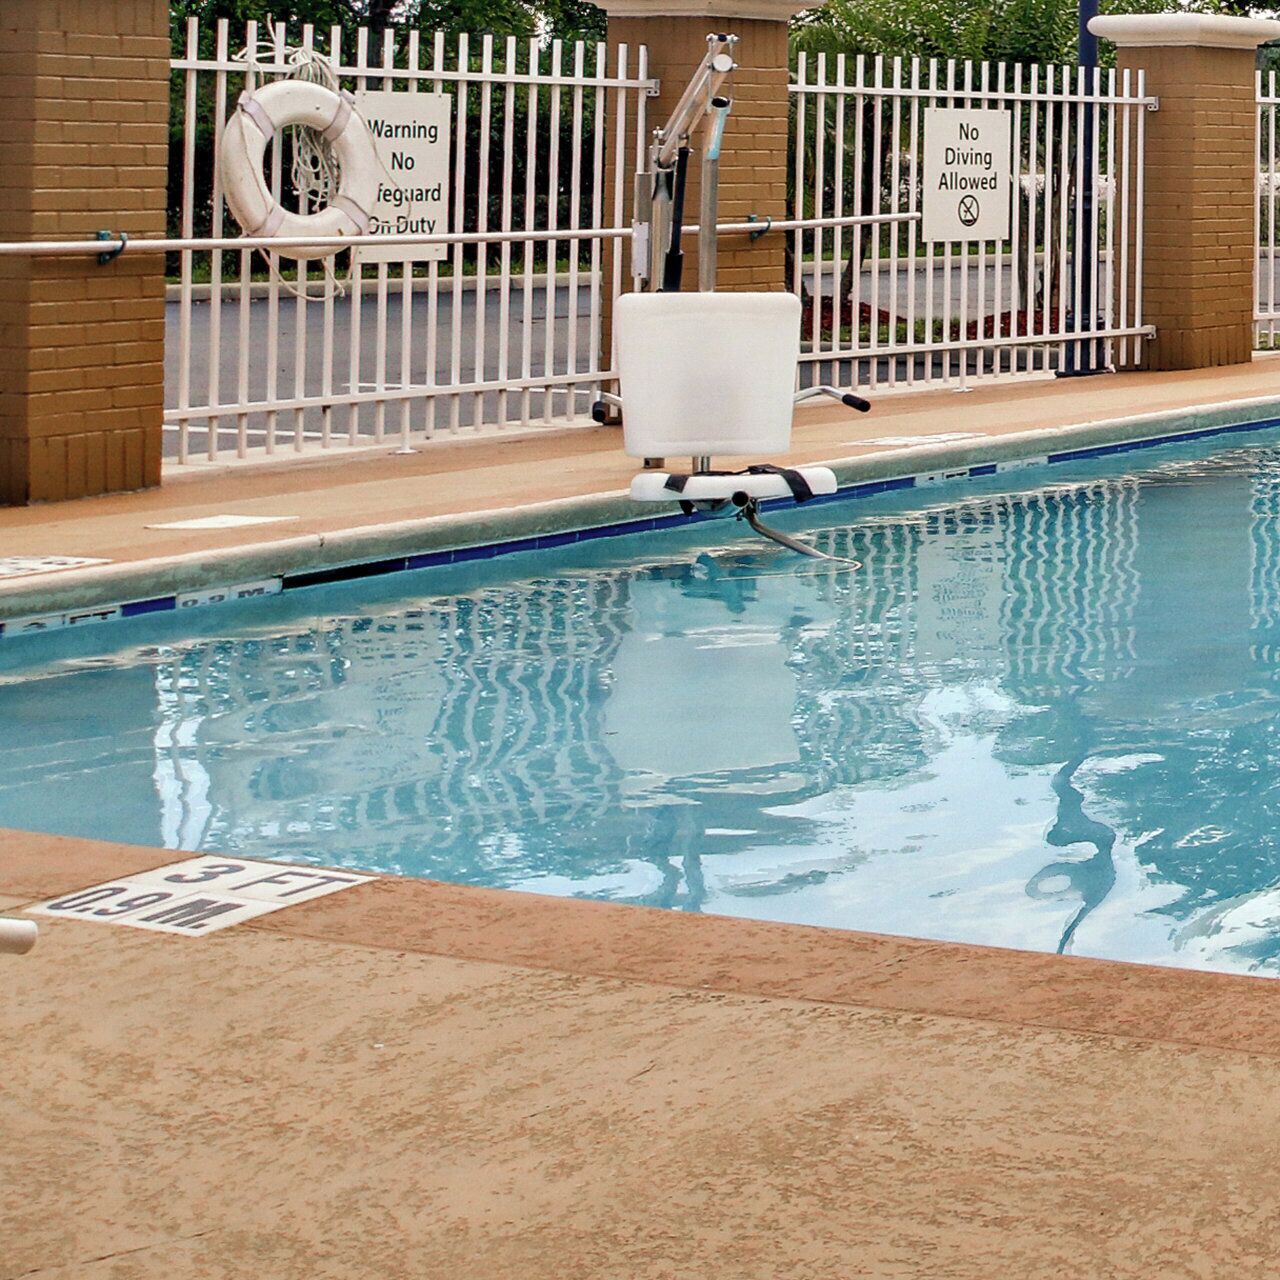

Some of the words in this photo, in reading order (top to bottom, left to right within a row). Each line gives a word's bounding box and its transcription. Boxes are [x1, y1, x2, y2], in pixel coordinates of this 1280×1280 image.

[367, 119, 438, 143] Warning
[960, 123, 980, 141] No
[392, 152, 415, 170] No
[945, 148, 992, 170] Diving
[938, 172, 997, 190] Allowed
[377, 183, 441, 207] feguard
[368, 216, 391, 234] On
[396, 216, 436, 234] Duty
[164, 864, 246, 883] 3
[228, 871, 356, 897] FT
[46, 886, 173, 916] 0.9
